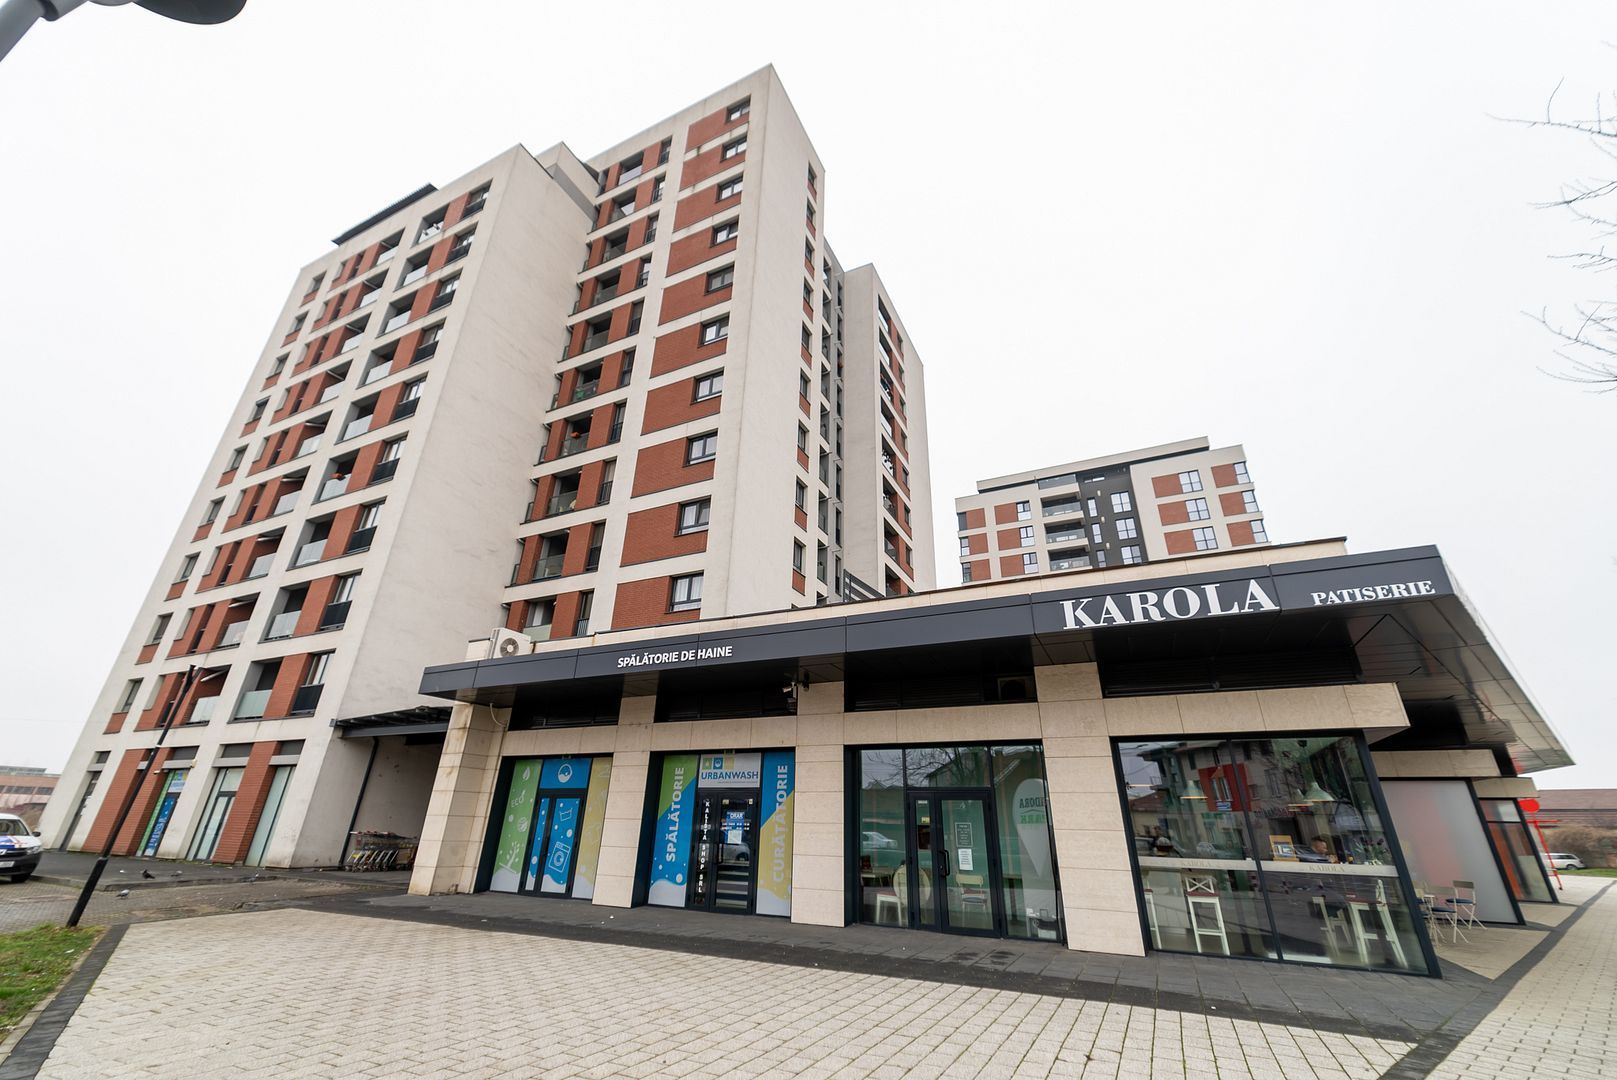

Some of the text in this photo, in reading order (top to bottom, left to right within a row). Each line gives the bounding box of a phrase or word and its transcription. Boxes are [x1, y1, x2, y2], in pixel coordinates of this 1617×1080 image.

[1060, 579, 1280, 630] KAROLA
[1311, 580, 1436, 606] PATISERIE
[617, 645, 733, 668] SPĂLĂTORIE DE HAINE
[701, 771, 759, 780] URBANWASH
[665, 767, 684, 862] SPĂLĂTORIE
